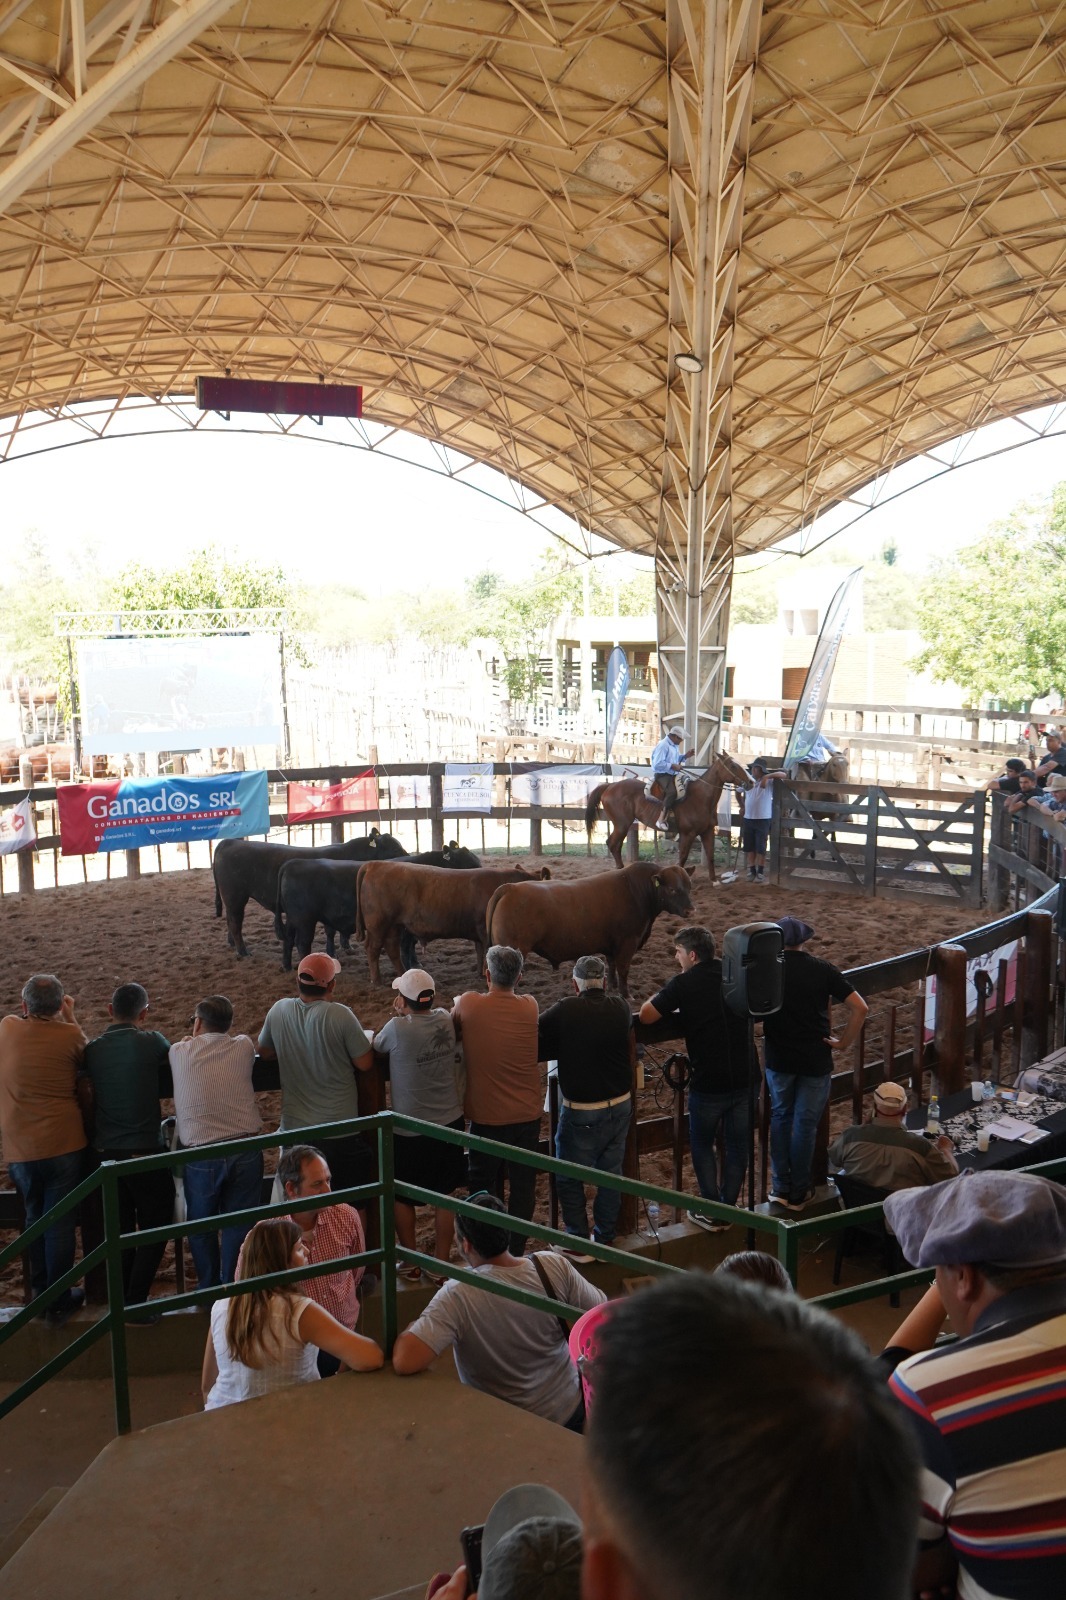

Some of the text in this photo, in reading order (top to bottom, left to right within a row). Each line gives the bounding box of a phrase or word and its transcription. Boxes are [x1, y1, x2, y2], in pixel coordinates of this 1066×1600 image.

[87, 788, 240, 819] Ganados SRL
[95, 815, 171, 828] CONSIGNATARIOS
[192, 810, 235, 819] HACIENDA
